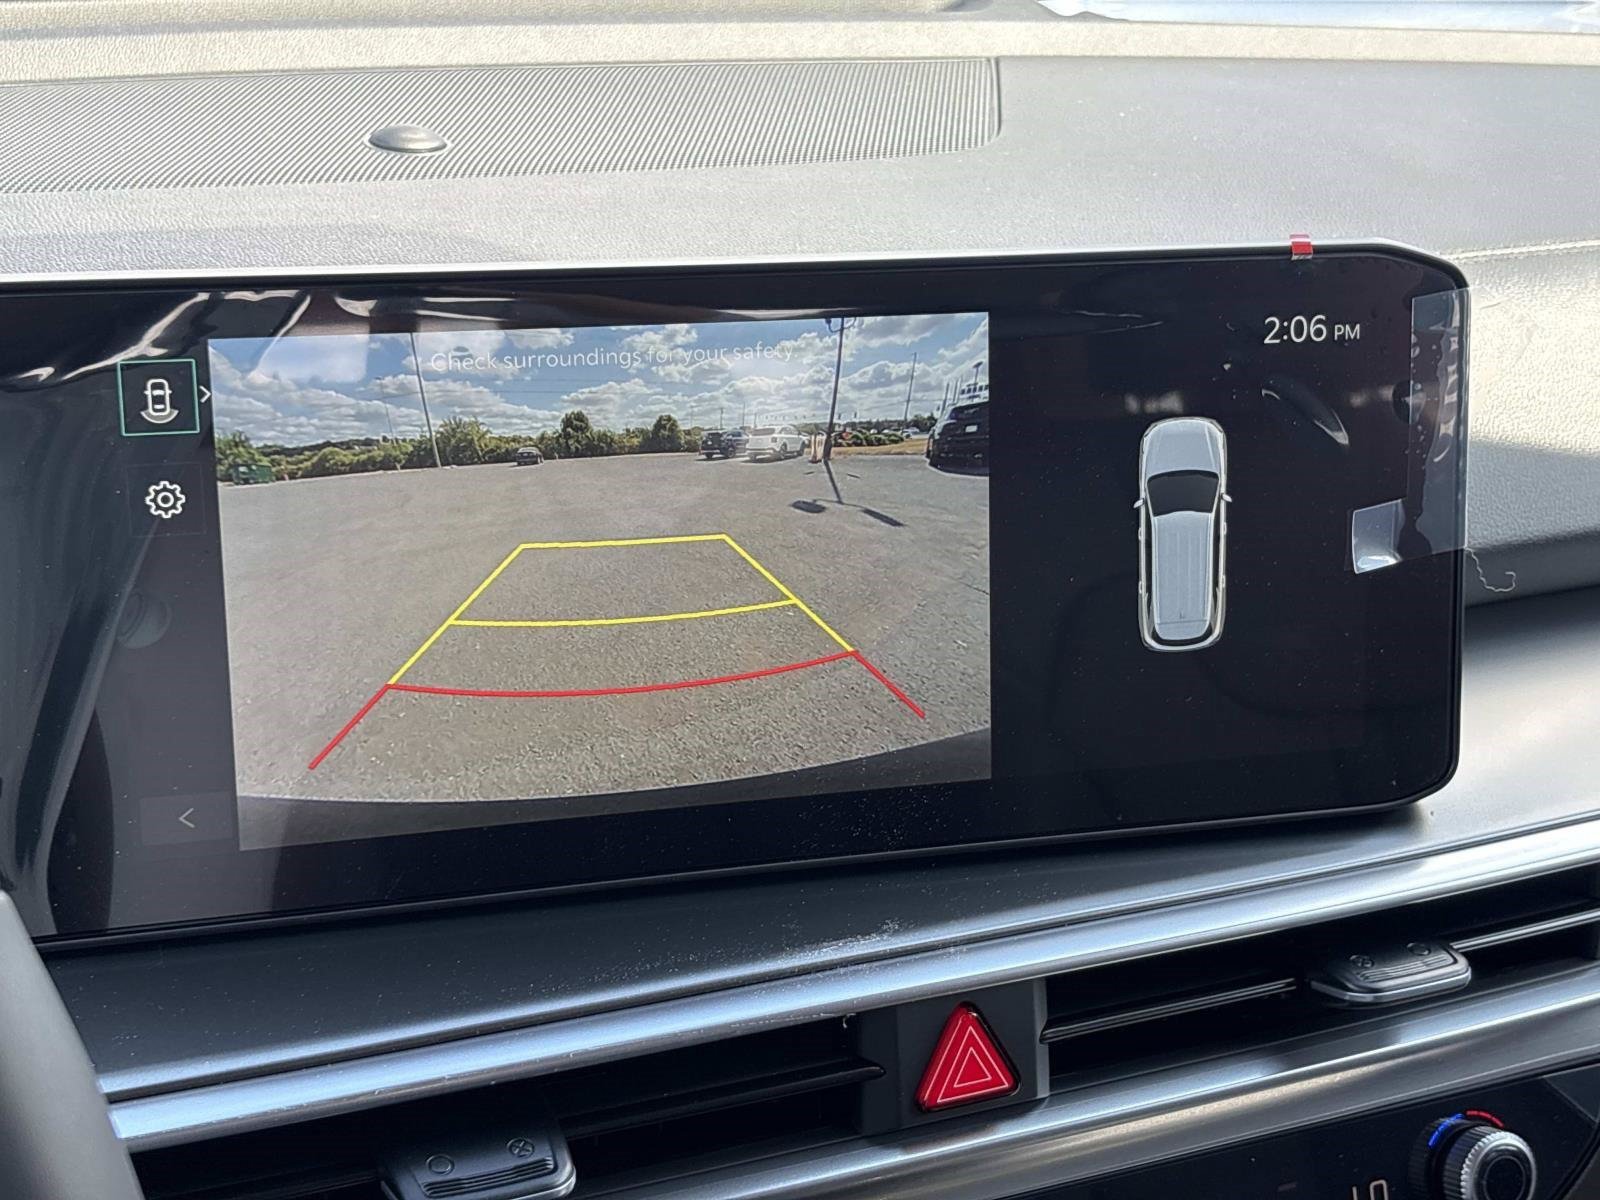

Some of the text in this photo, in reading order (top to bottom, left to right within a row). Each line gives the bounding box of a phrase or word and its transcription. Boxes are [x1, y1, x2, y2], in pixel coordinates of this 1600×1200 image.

[1263, 314, 1361, 344] 2:06 PM
[431, 341, 799, 371] Check surroundings for your safety.
